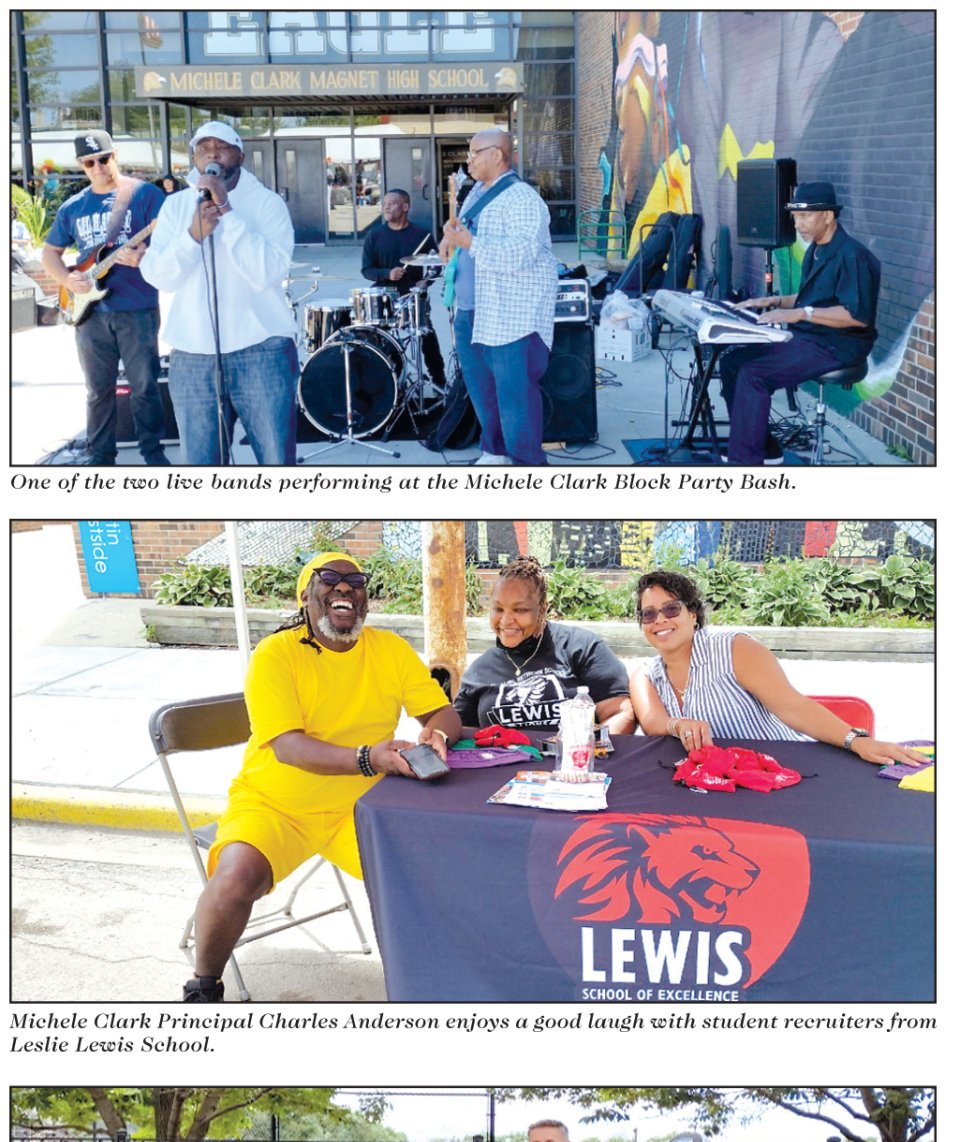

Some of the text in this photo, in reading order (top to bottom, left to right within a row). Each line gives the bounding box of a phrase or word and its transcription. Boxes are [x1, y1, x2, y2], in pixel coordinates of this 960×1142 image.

[170, 68, 489, 91] MICHELE CLARK MAGNET HIGH SCHOOL
[10, 472, 796, 494] One of the two live bands performing at the Michele Clark Block Party Bash.
[105, 522, 121, 545] tin
[499, 704, 562, 724] LEWIS
[581, 926, 744, 987] LEWIS
[581, 988, 739, 1002] SCHOOL OF EXCELLENCE
[10, 1036, 215, 1053] Leslie Lewis School.
